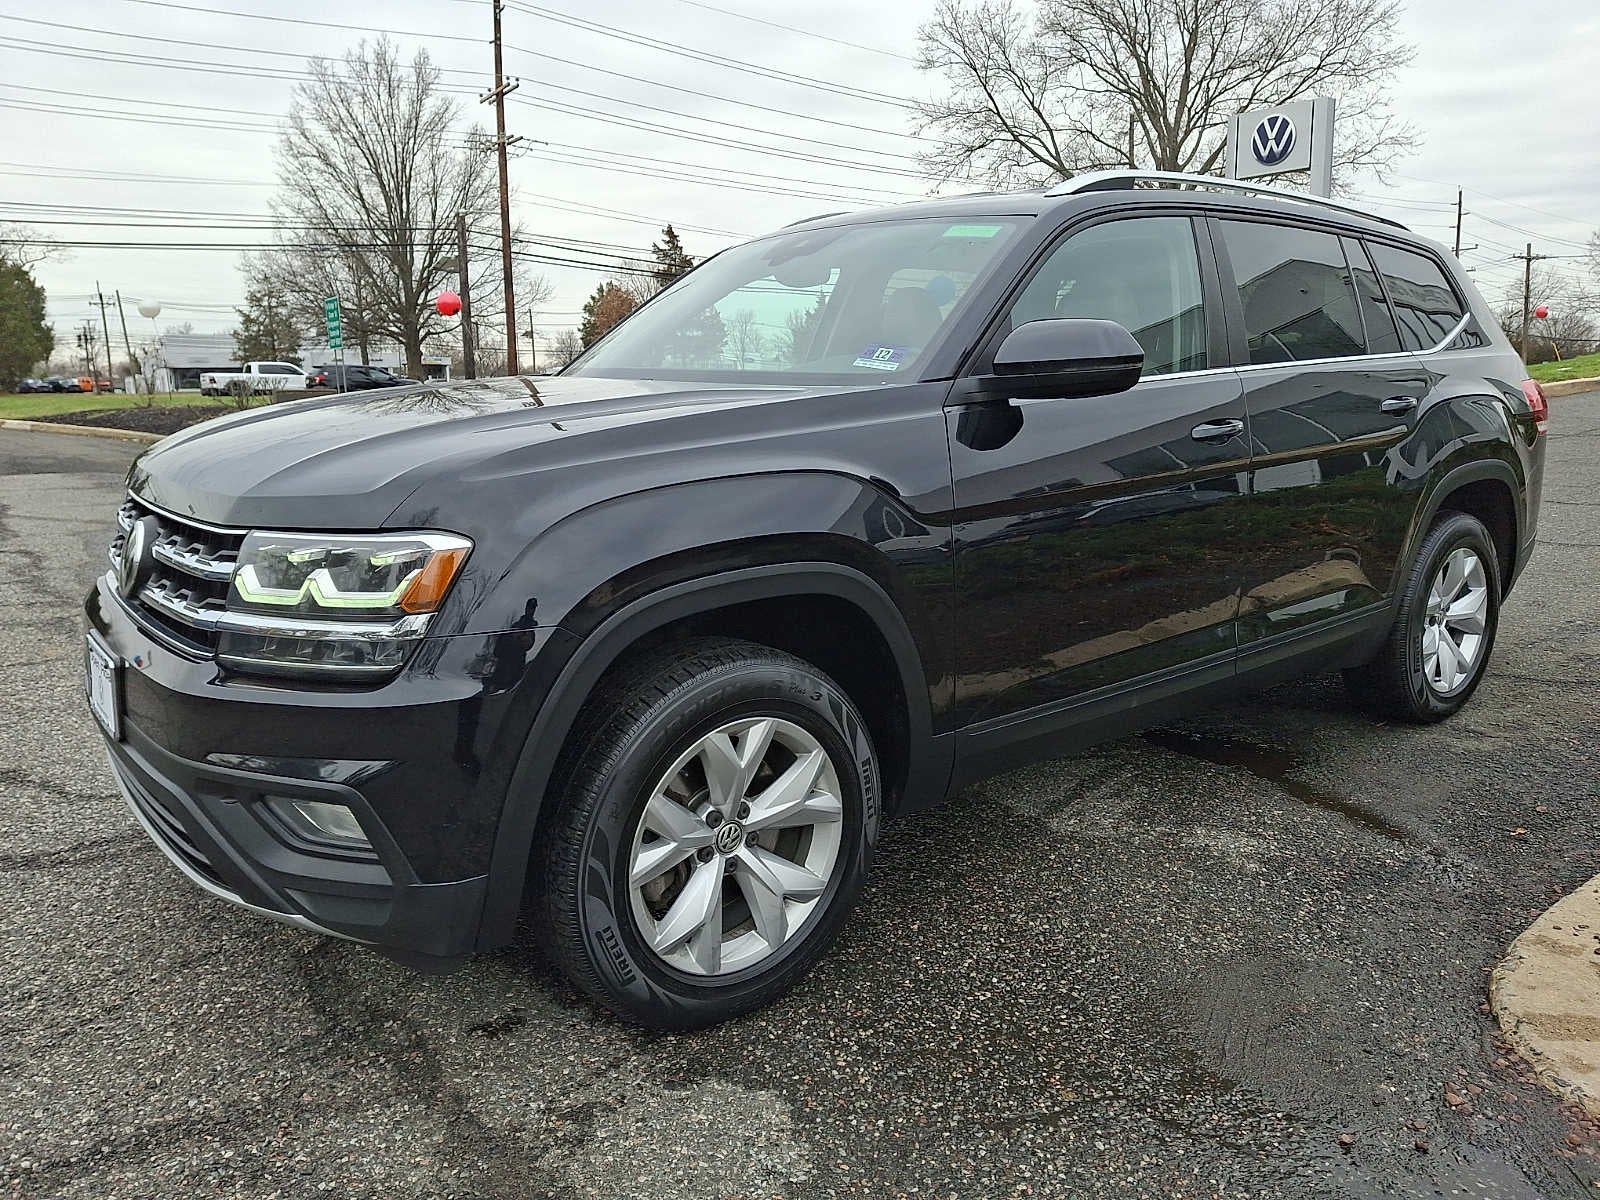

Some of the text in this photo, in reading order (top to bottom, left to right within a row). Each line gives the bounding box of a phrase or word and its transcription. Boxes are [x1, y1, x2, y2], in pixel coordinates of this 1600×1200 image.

[1251, 114, 1296, 166] VW
[875, 349, 890, 359] 12
[810, 691, 823, 701] 3
[861, 756, 876, 820] PIRELLI
[717, 823, 742, 853] VW
[595, 926, 637, 987] PIRELLI
